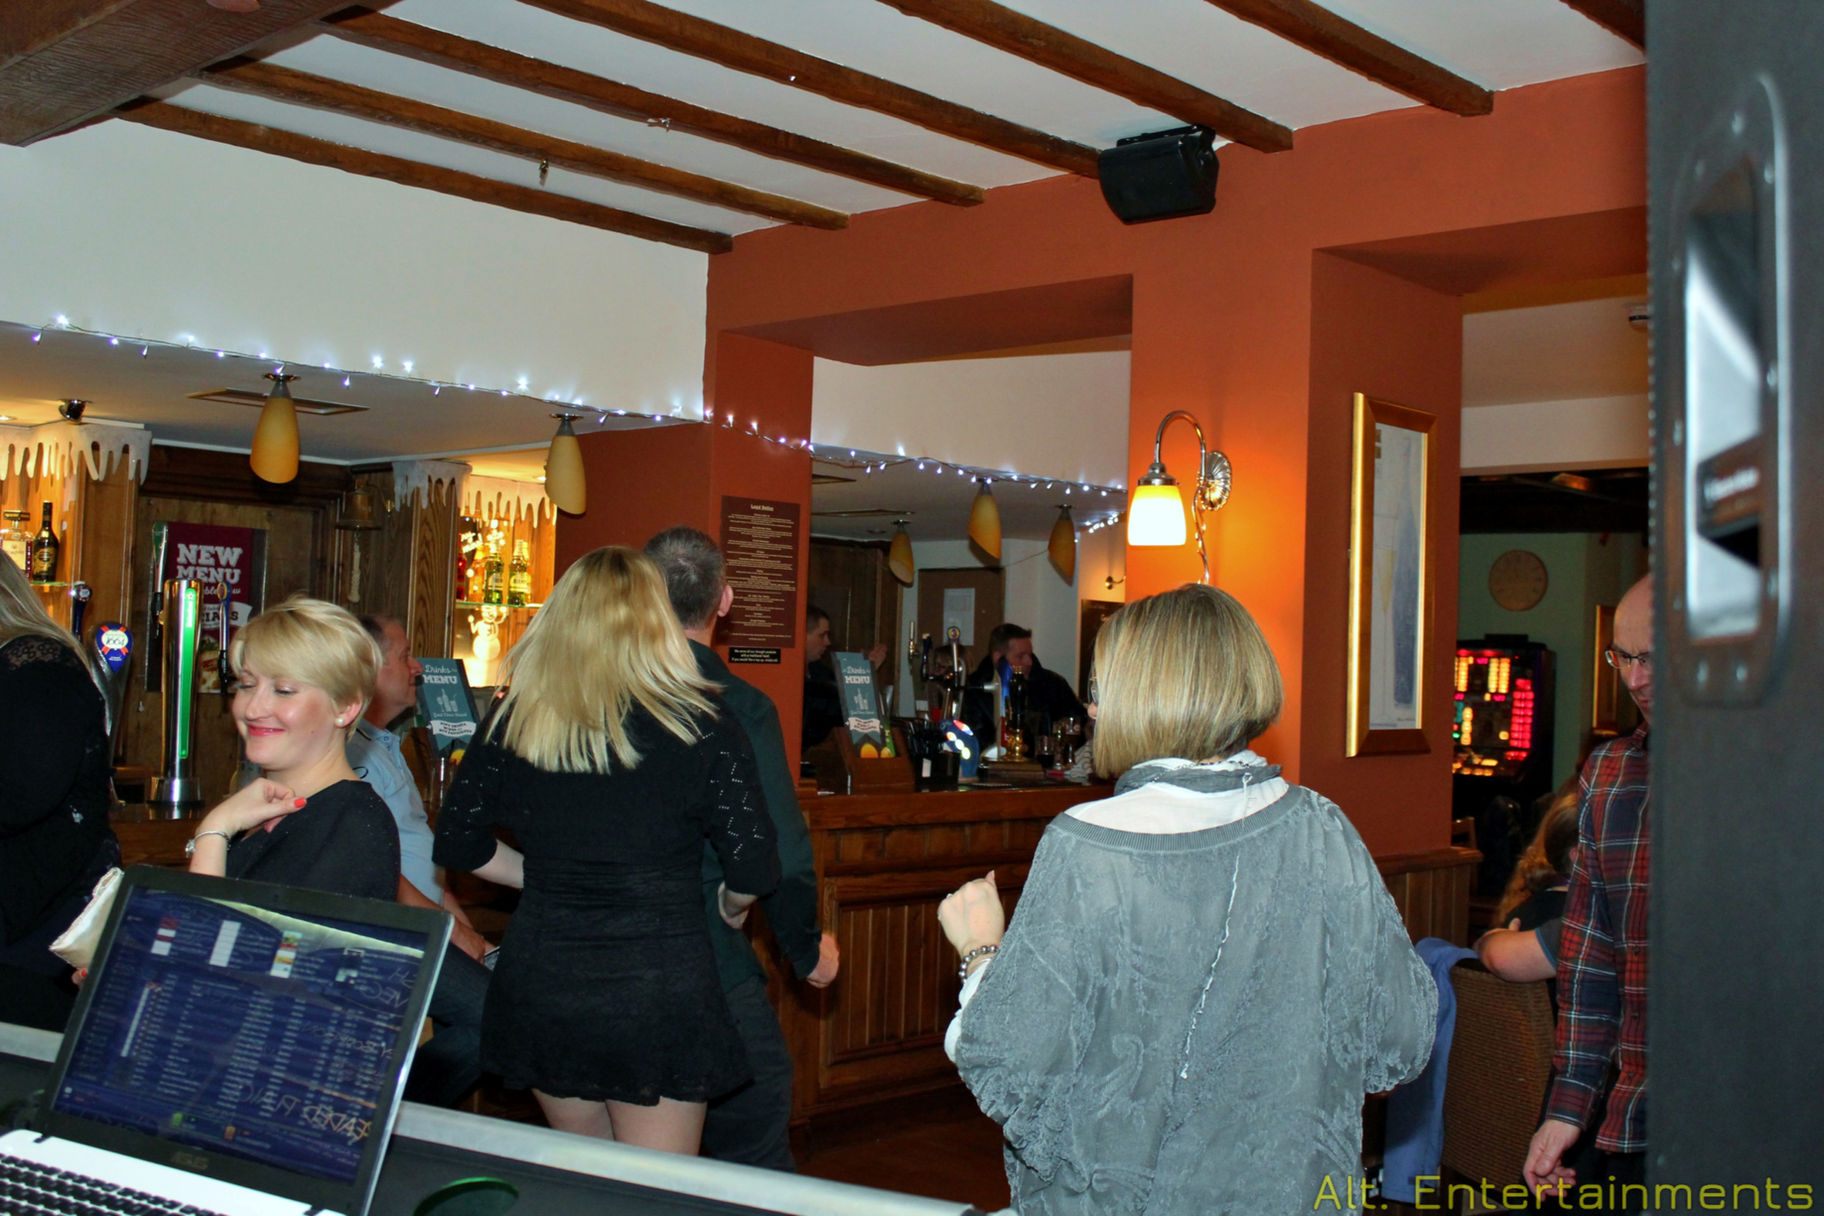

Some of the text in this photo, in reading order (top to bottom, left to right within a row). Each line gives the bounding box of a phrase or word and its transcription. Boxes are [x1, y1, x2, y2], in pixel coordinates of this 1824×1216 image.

[177, 544, 243, 567] NEW
[176, 566, 241, 584] MENU
[425, 664, 452, 674] Drinks
[422, 674, 458, 685] MENU
